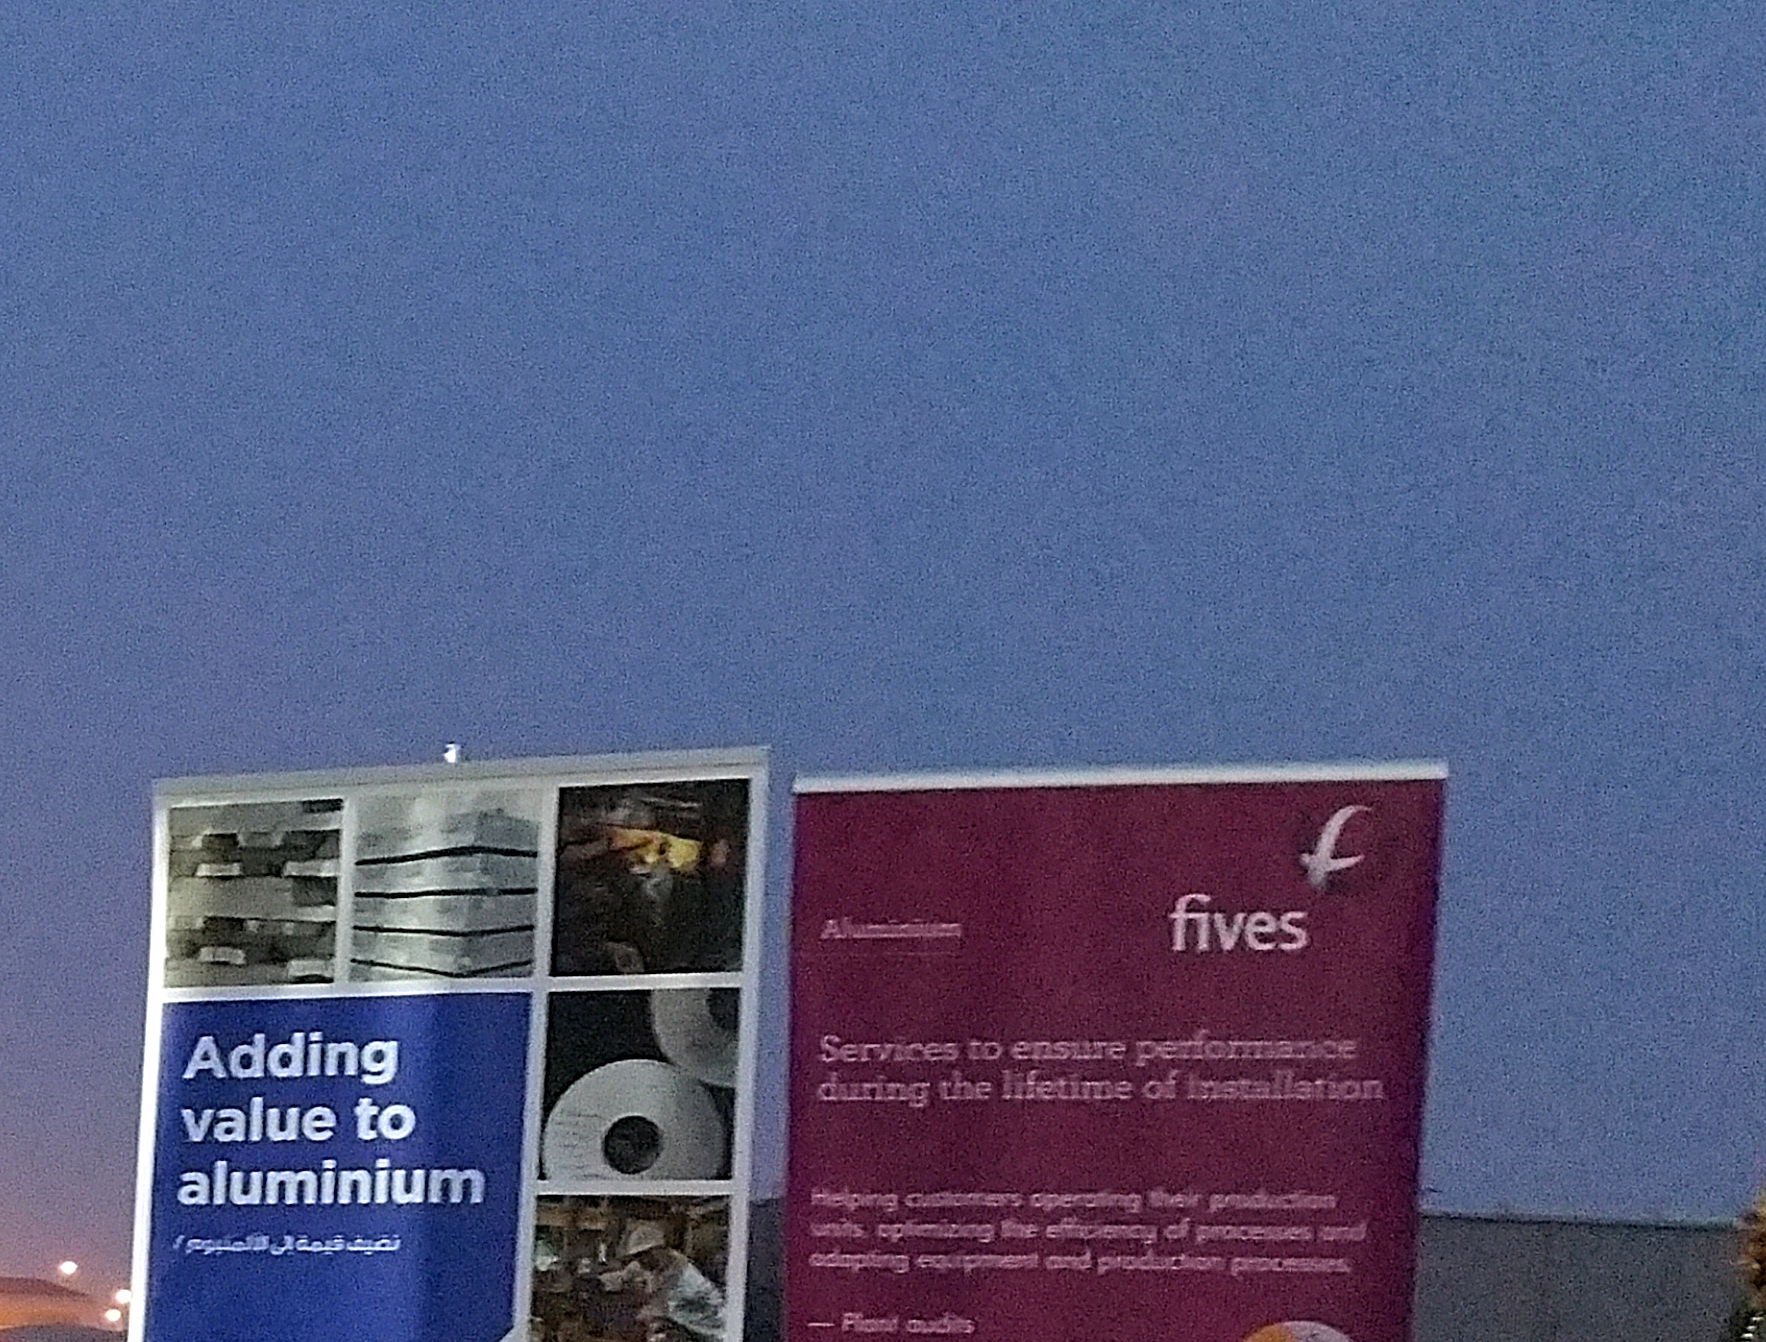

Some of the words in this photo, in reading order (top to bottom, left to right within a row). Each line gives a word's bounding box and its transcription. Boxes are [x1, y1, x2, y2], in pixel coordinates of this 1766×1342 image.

[1169, 893, 1310, 952] fives
[181, 1031, 399, 1084] Adding
[821, 1034, 959, 1062] Services
[967, 1039, 1002, 1060] to
[1012, 1041, 1126, 1060] ensure
[1135, 1029, 1357, 1067] performance
[818, 1071, 930, 1107] during
[938, 1070, 992, 1100] the
[1001, 1069, 1132, 1100] lifetime
[1142, 1069, 1178, 1100] of
[181, 1096, 337, 1142] value
[354, 1097, 416, 1141] to
[176, 1158, 486, 1205] aluminium
[811, 1188, 898, 1212] Helping
[904, 1191, 1023, 1207] customers
[1029, 1192, 1142, 1213] operating
[1148, 1187, 1200, 1208] their
[1208, 1188, 1336, 1213] production
[1001, 1219, 1039, 1239] the
[1045, 1217, 1158, 1245] efficiency
[1163, 1217, 1191, 1239] of
[1195, 1225, 1313, 1244] processes
[1320, 1222, 1366, 1241] and
[809, 1250, 909, 1273] adapting
[917, 1253, 1039, 1275] equipment
[1045, 1253, 1092, 1270] and
[1096, 1250, 1225, 1275] production
[841, 1312, 899, 1332] Plant
[905, 1312, 975, 1333] audits
